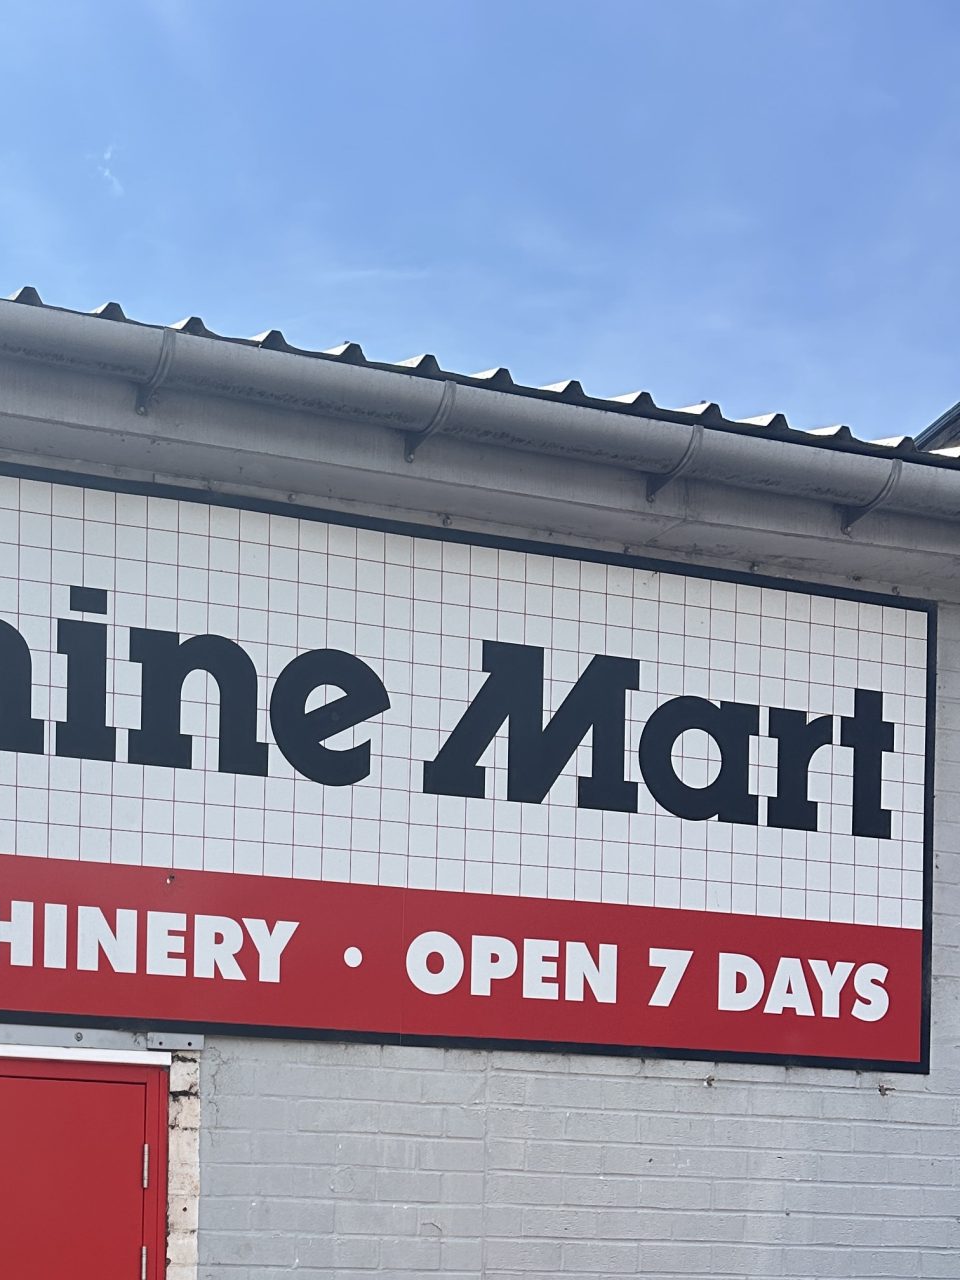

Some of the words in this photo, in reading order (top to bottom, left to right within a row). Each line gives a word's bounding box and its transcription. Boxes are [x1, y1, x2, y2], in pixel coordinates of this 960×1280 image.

[422, 640, 894, 840] Mart
[406, 931, 618, 1004] OPEN
[648, 948, 694, 1007] 7
[717, 953, 890, 1022] DAYS
